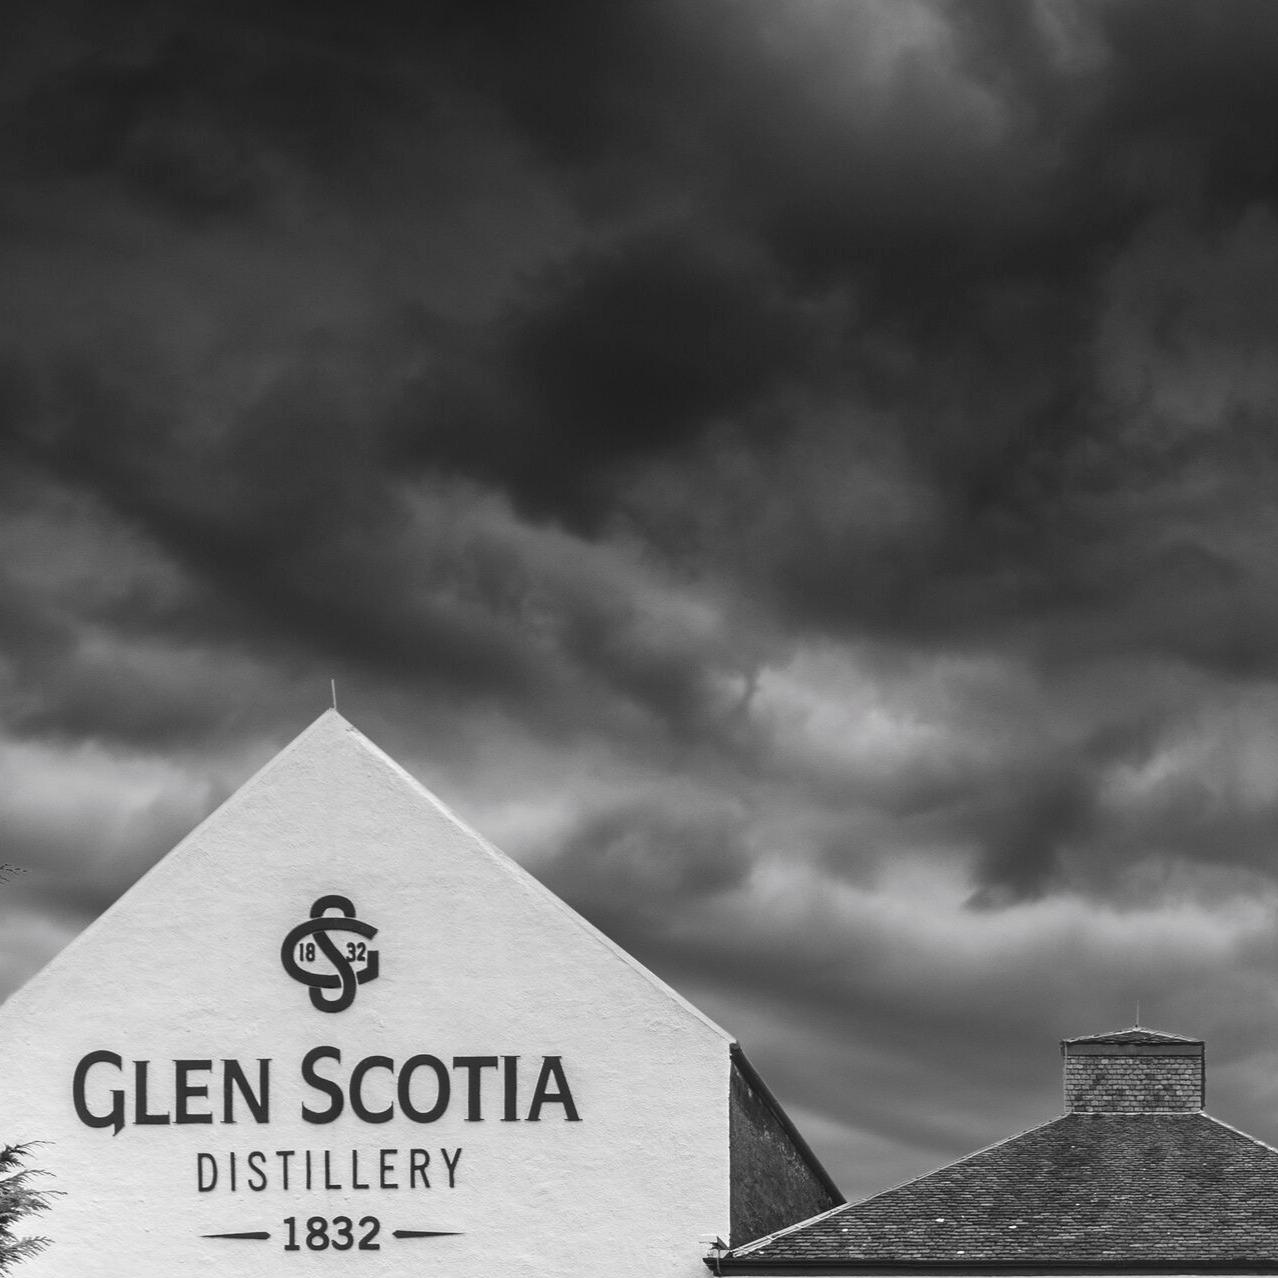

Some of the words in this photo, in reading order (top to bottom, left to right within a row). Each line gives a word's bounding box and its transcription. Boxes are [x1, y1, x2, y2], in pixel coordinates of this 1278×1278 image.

[299, 942, 316, 962] 18
[345, 941, 367, 963] 32
[72, 1049, 273, 1137] GLEN
[300, 1045, 583, 1126] SCOTIA
[196, 1147, 463, 1192] DISTILLERY
[283, 1215, 381, 1252] 1832
